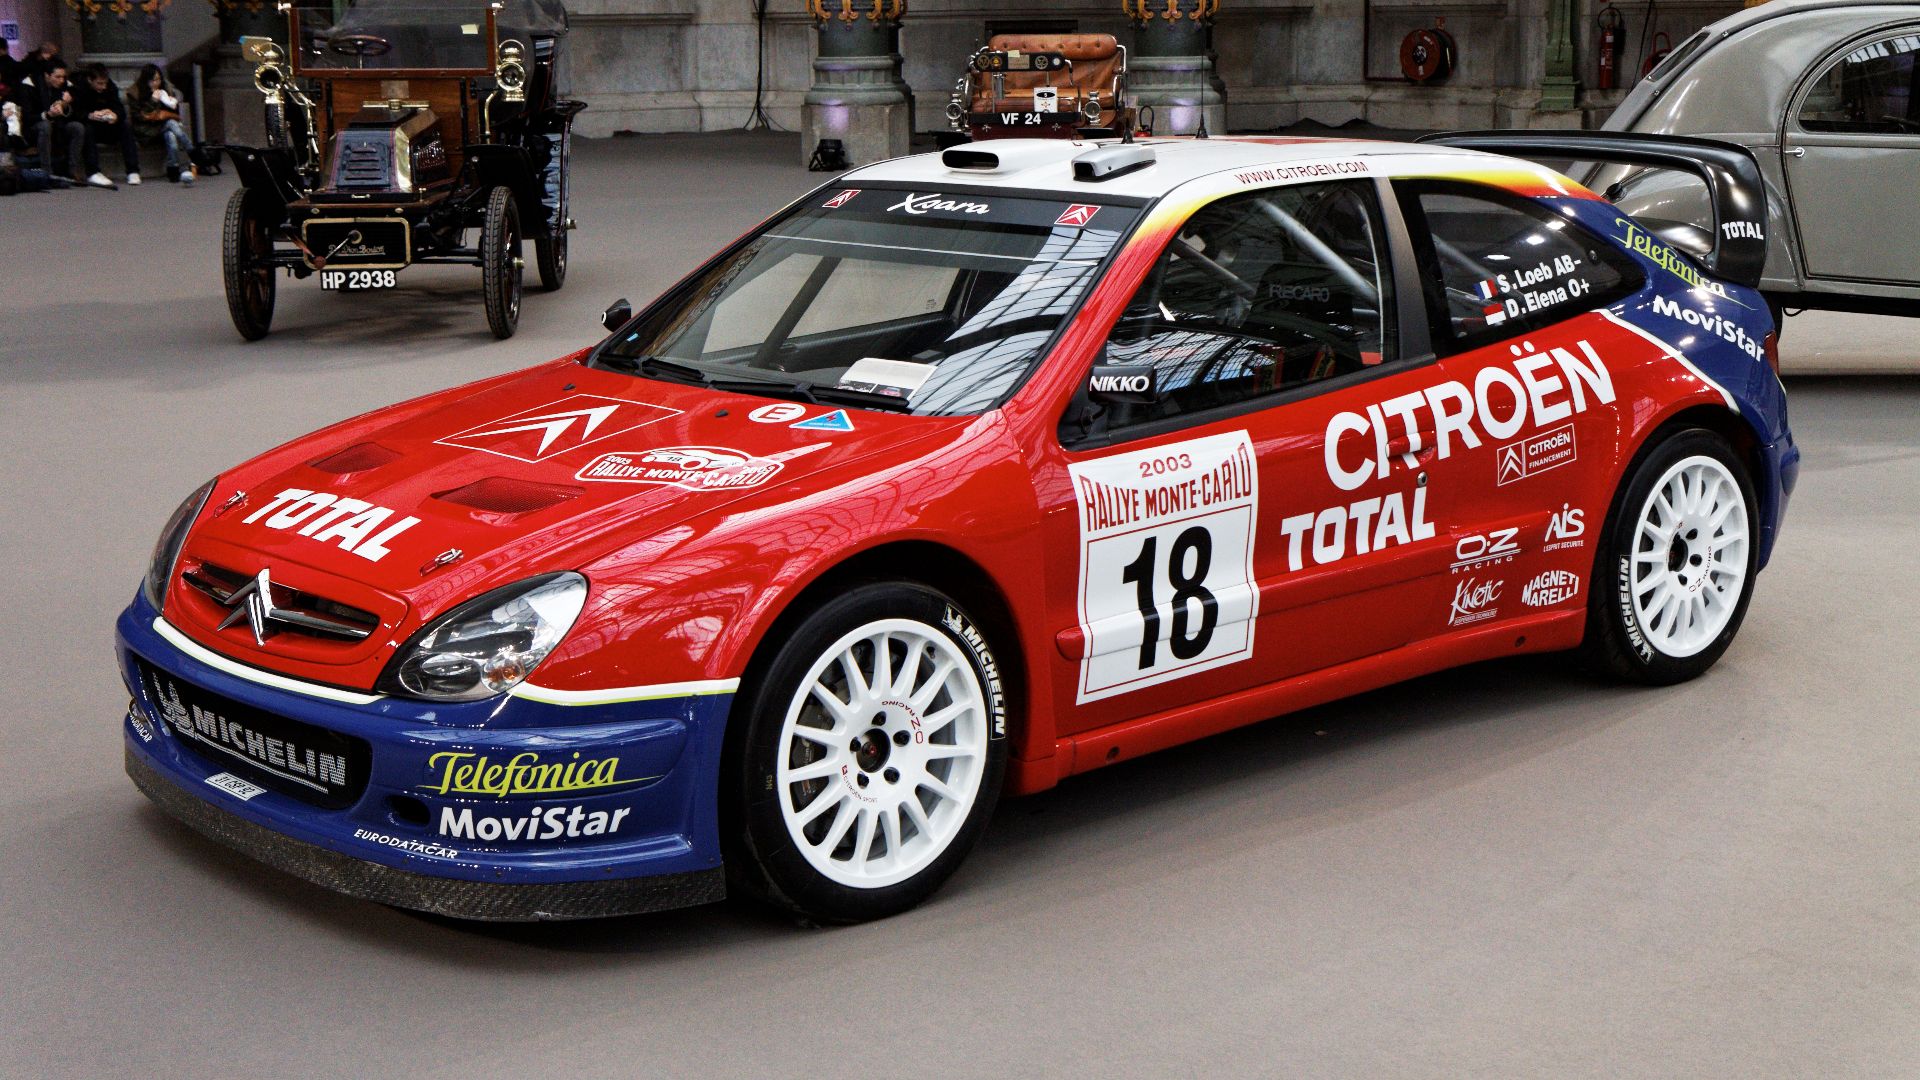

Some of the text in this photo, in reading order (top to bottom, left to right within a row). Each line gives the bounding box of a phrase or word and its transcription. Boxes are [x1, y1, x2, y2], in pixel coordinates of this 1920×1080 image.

[1001, 112, 1041, 125] VF 24
[1234, 161, 1369, 185] WWW.CITROEN.COM
[886, 193, 990, 214] Xsara
[1721, 221, 1764, 240] TOTAL
[1553, 254, 1582, 277] AB-
[321, 270, 396, 289] HP 2938
[1269, 283, 1330, 302] RECARO
[1652, 294, 1765, 362] MoviStar
[1089, 375, 1150, 392] NIKKO
[758, 406, 796, 420] E
[1324, 340, 1617, 491] CITROËN
[1528, 431, 1571, 456] CITROËN
[587, 460, 645, 478] RALLYE
[604, 454, 632, 465] 2003
[1139, 453, 1193, 478] 2003
[1528, 448, 1572, 469] FINANCEMENT
[1079, 474, 1140, 532] RALLYE
[242, 488, 422, 562] TOTAL
[1281, 486, 1436, 571] TOTAL
[1451, 555, 1513, 575] RACING
[1123, 526, 1219, 670] 18
[1521, 570, 1580, 606] MAGNETI
[1619, 557, 1645, 648] MICHELIN
[963, 624, 1006, 735] MICHELIN
[881, 700, 915, 717] RACING
[192, 703, 346, 787] MICHELIN
[439, 805, 631, 842] MoviStar
[353, 828, 458, 859] EURODATACAR
